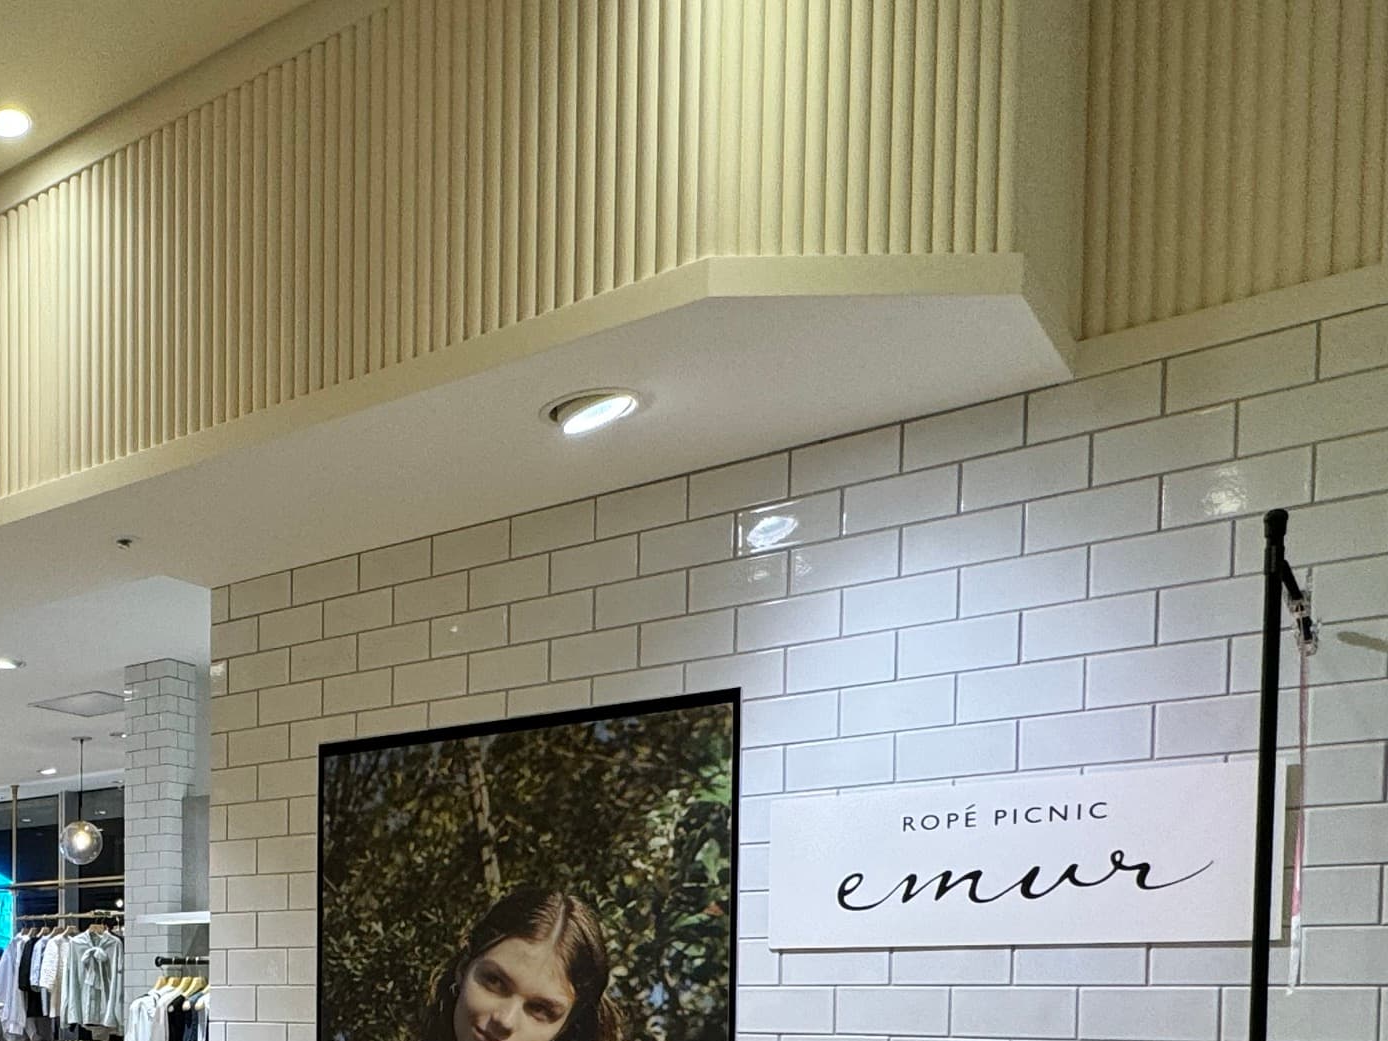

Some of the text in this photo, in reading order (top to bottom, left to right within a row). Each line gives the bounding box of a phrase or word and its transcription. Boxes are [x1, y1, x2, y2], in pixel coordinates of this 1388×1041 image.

[902, 802, 1109, 832] ROPÉ PICNIC
[837, 850, 1215, 911] emur
